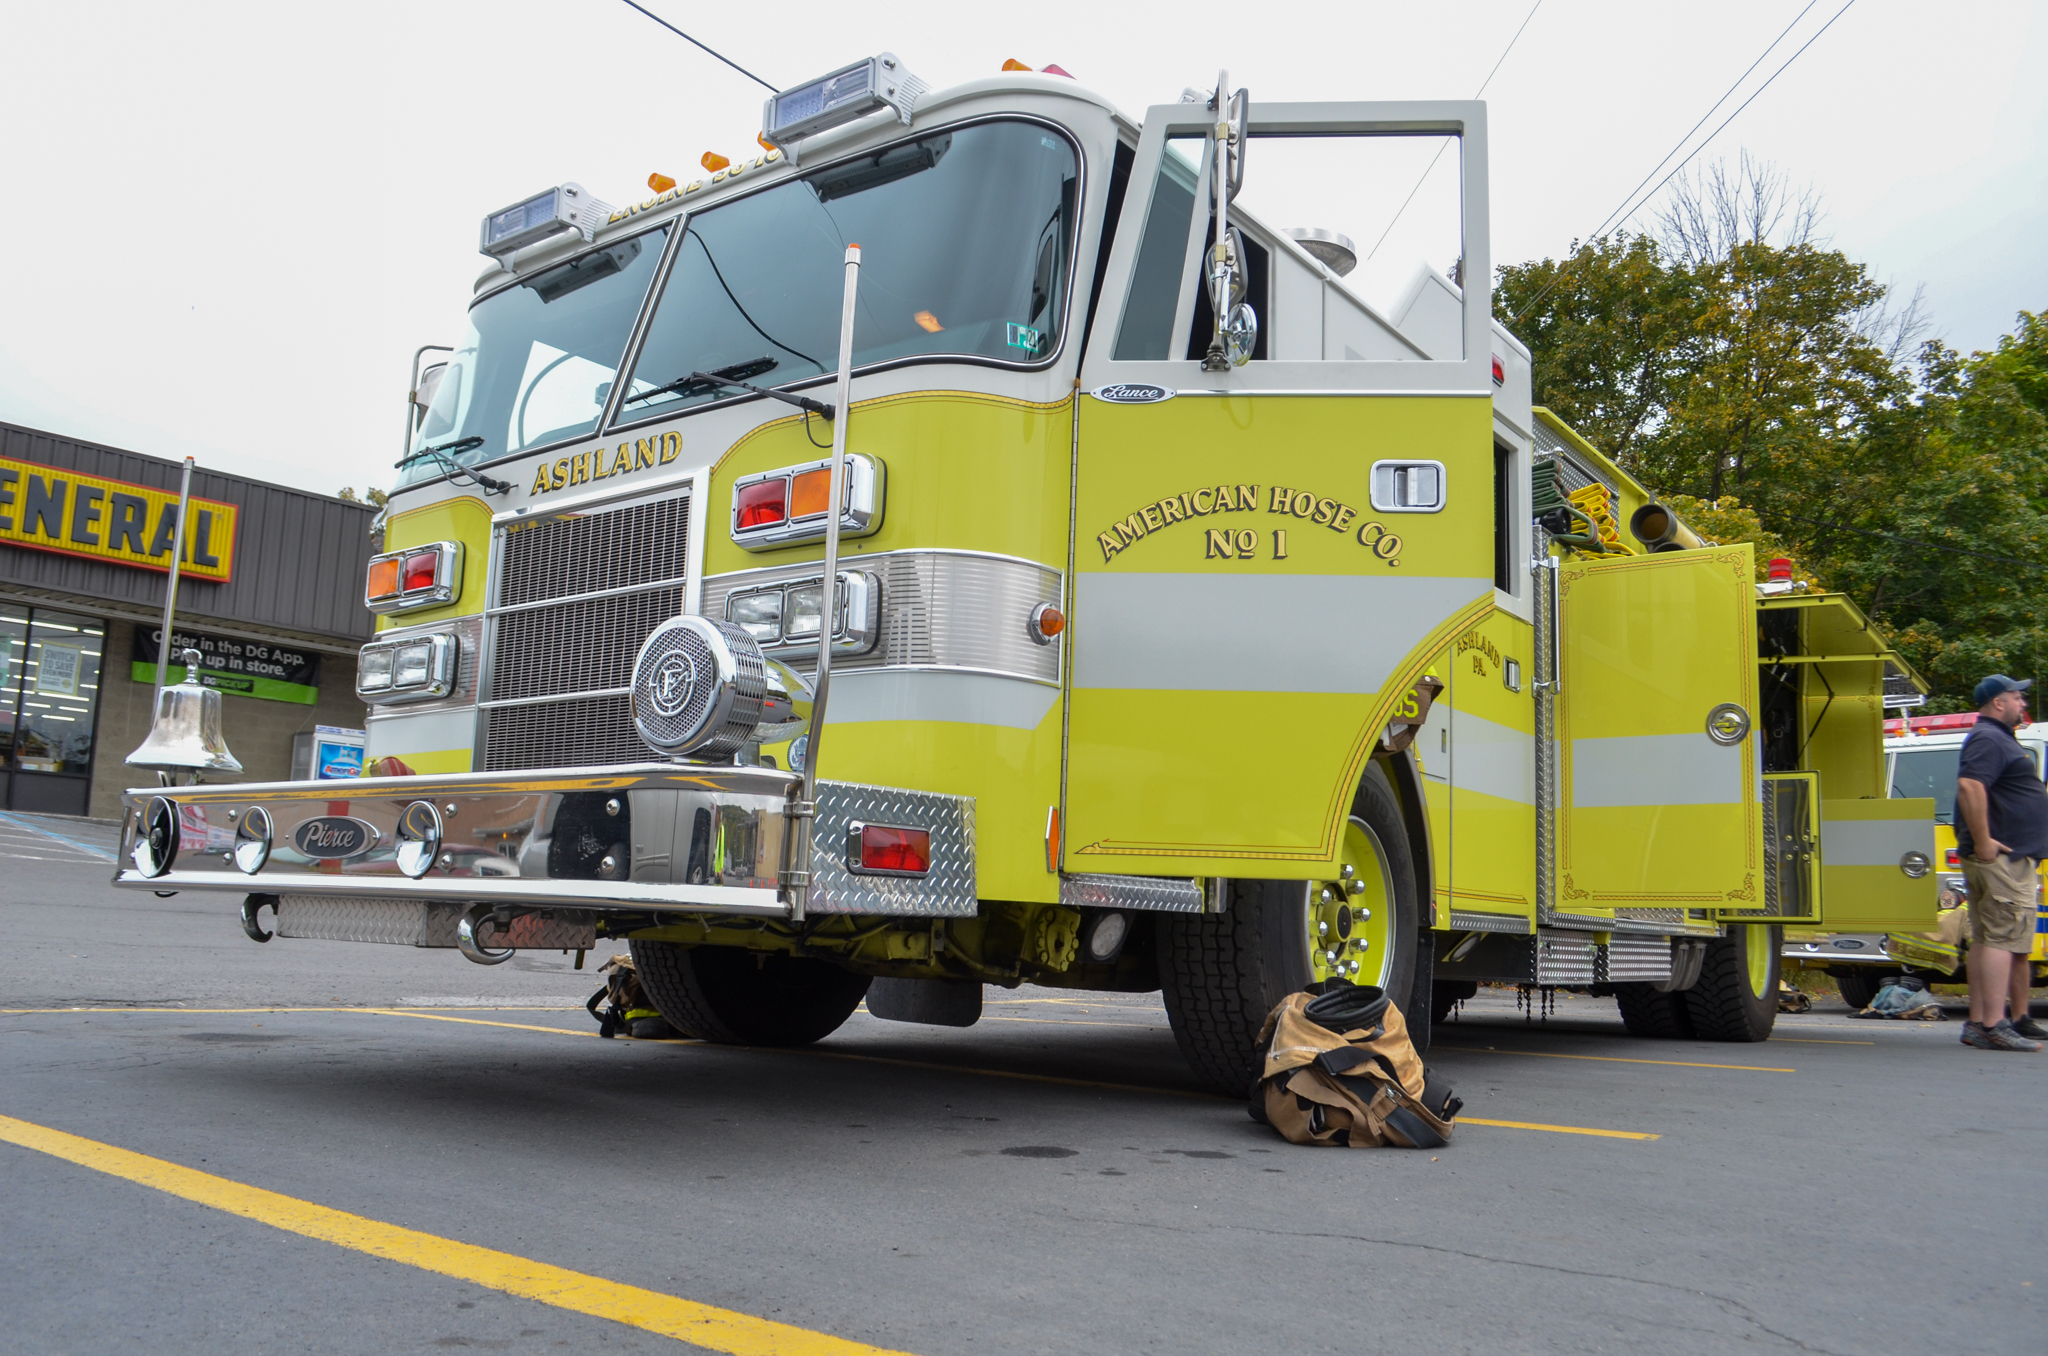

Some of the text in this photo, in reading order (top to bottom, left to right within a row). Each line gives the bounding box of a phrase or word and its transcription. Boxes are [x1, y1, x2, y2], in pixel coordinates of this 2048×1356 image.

[1103, 385, 1159, 399] Lance
[529, 431, 682, 497] ASHLAND
[1097, 484, 1403, 567] AMERICAN HOSE CO.
[44, 649, 76, 663] SWITCH
[152, 630, 305, 665] Oder in the DG App.
[1457, 630, 1500, 669] ASHLAND
[43, 659, 74, 672] TO SAVE
[206, 656, 225, 670] up
[229, 655, 243, 670] in
[246, 660, 285, 676] store.
[1472, 655, 1487, 677] PA.
[302, 821, 355, 852] Pierce
